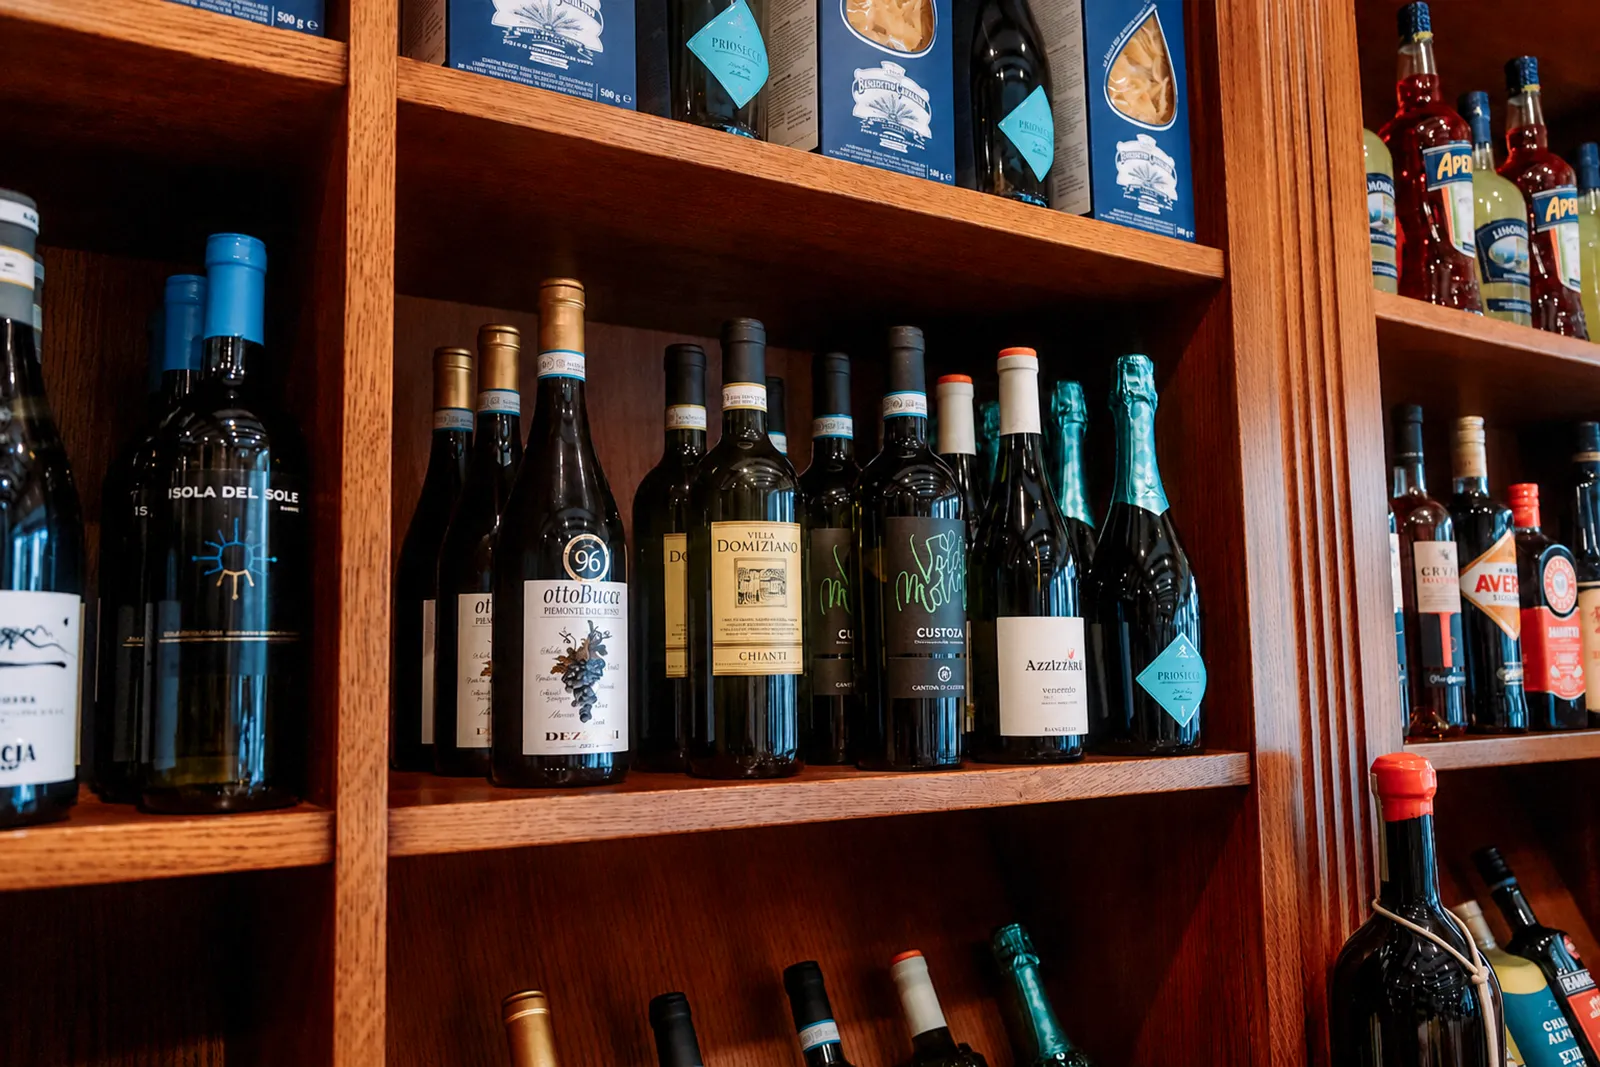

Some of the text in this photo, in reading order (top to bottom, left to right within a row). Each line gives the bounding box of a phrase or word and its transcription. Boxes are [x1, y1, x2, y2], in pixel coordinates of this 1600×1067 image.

[276, 12, 295, 25] 500
[600, 88, 614, 100] 500
[168, 486, 299, 503] ISOLA DEL SOLE
[134, 506, 149, 516] IS
[717, 539, 798, 553] DOMIZIANO
[574, 549, 601, 572] 96
[544, 606, 585, 615] PIEMONTE
[916, 628, 963, 638] CUSTOZA
[739, 651, 787, 661] CHIANTI
[545, 730, 619, 741] DEZI
